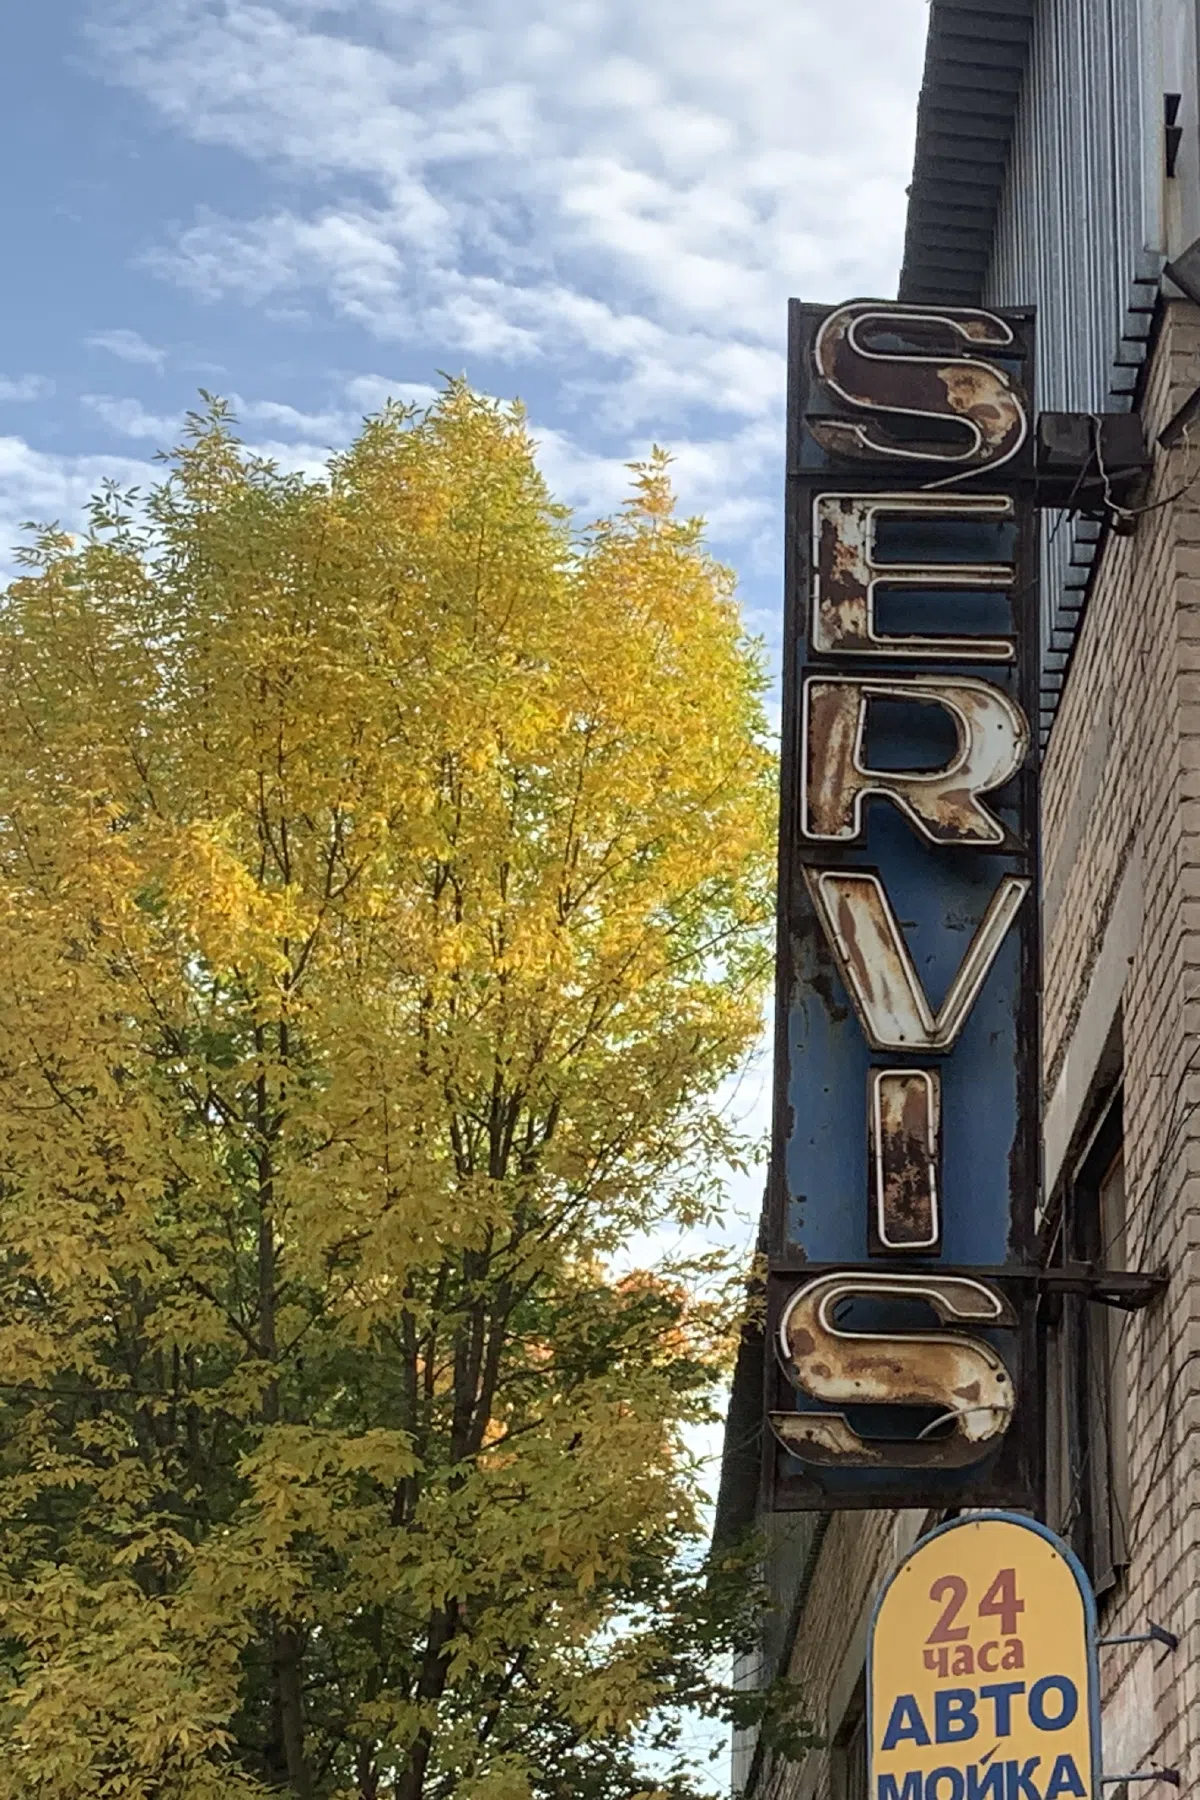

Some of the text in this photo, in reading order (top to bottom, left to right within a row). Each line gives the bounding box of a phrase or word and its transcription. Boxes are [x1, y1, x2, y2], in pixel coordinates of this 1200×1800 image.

[768, 300, 1031, 1472] SERVIS
[924, 1567, 1026, 1645] 24
[922, 1637, 1026, 1679] часа
[880, 1674, 1079, 1752] АВТО
[877, 1742, 1088, 1800] МОЙКА
